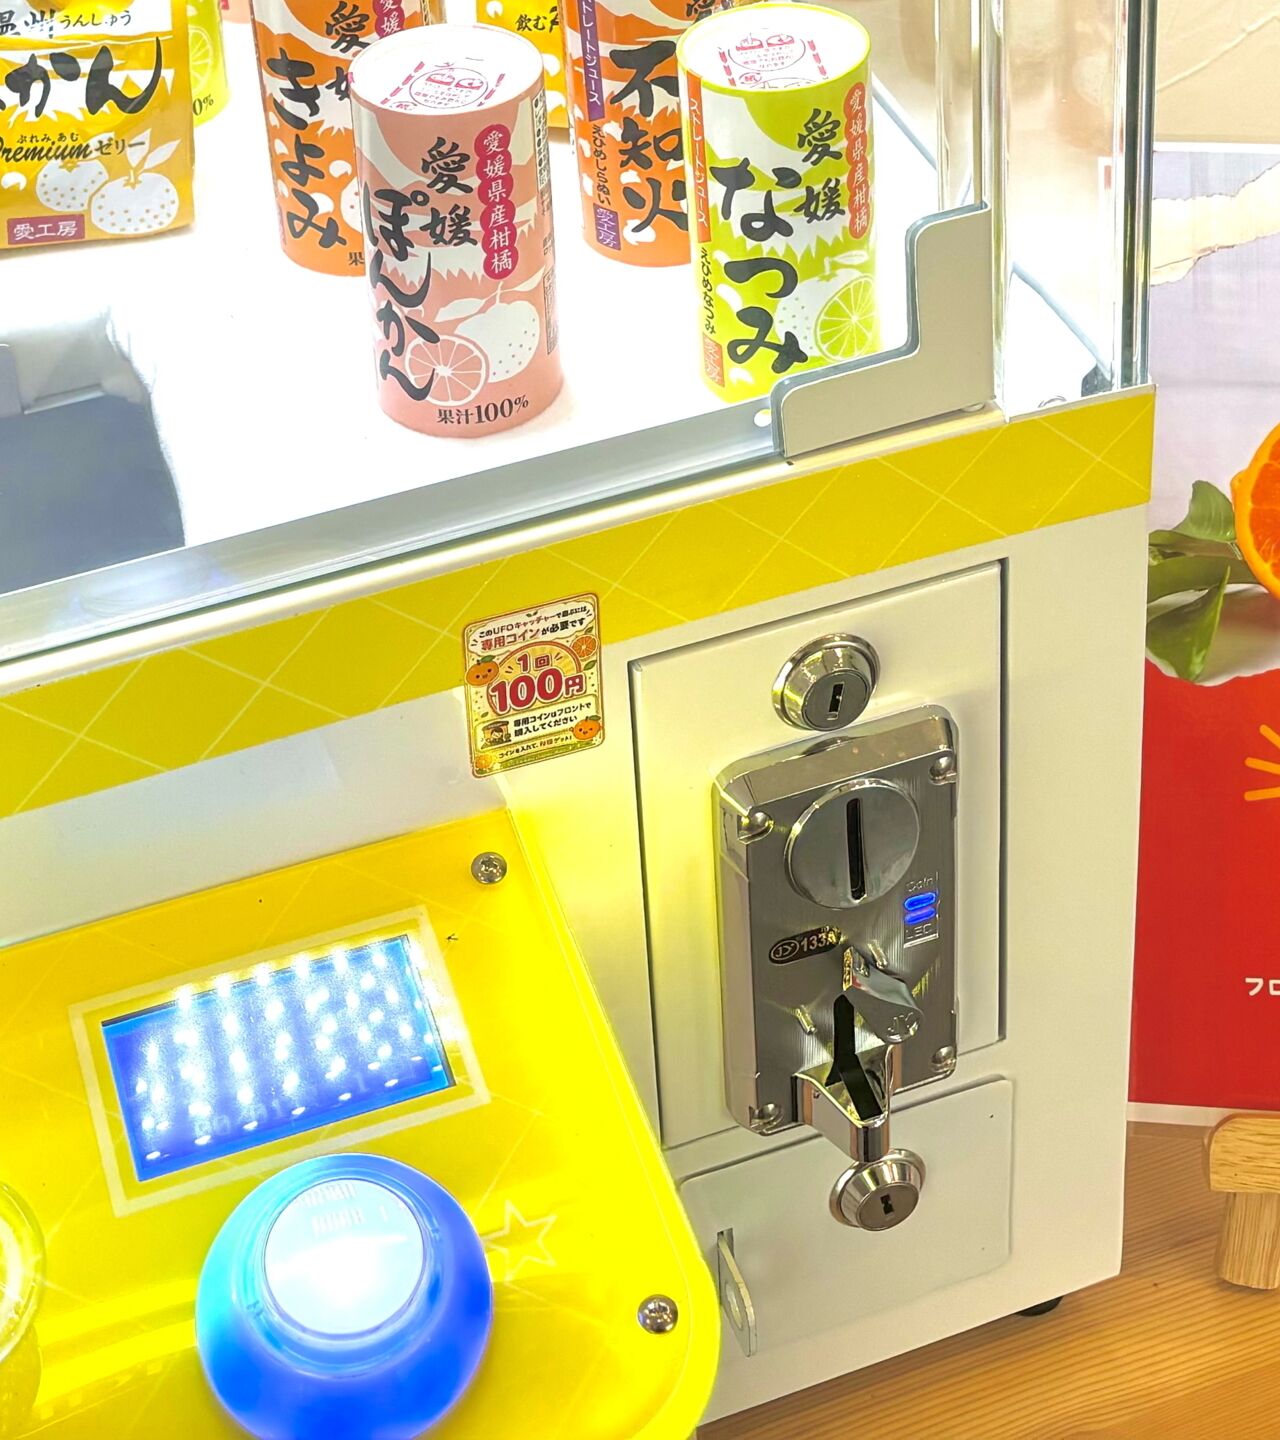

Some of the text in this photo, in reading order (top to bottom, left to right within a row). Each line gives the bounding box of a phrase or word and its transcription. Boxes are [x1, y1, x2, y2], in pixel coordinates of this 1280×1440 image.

[266, 47, 347, 249] きよみ
[419, 136, 478, 247] 愛媛
[609, 41, 689, 233] 不知火
[793, 108, 846, 224] 愛媛
[849, 90, 870, 233] 愛媛県産柑橘
[13, 220, 77, 241] 愛工房
[482, 130, 512, 275] 愛媛県産柑橘
[709, 157, 809, 374] なつみ
[363, 182, 440, 401] ぽんかん
[437, 394, 529, 425] 果汁100%
[491, 668, 585, 713] 100円
[517, 653, 551, 672] 1回
